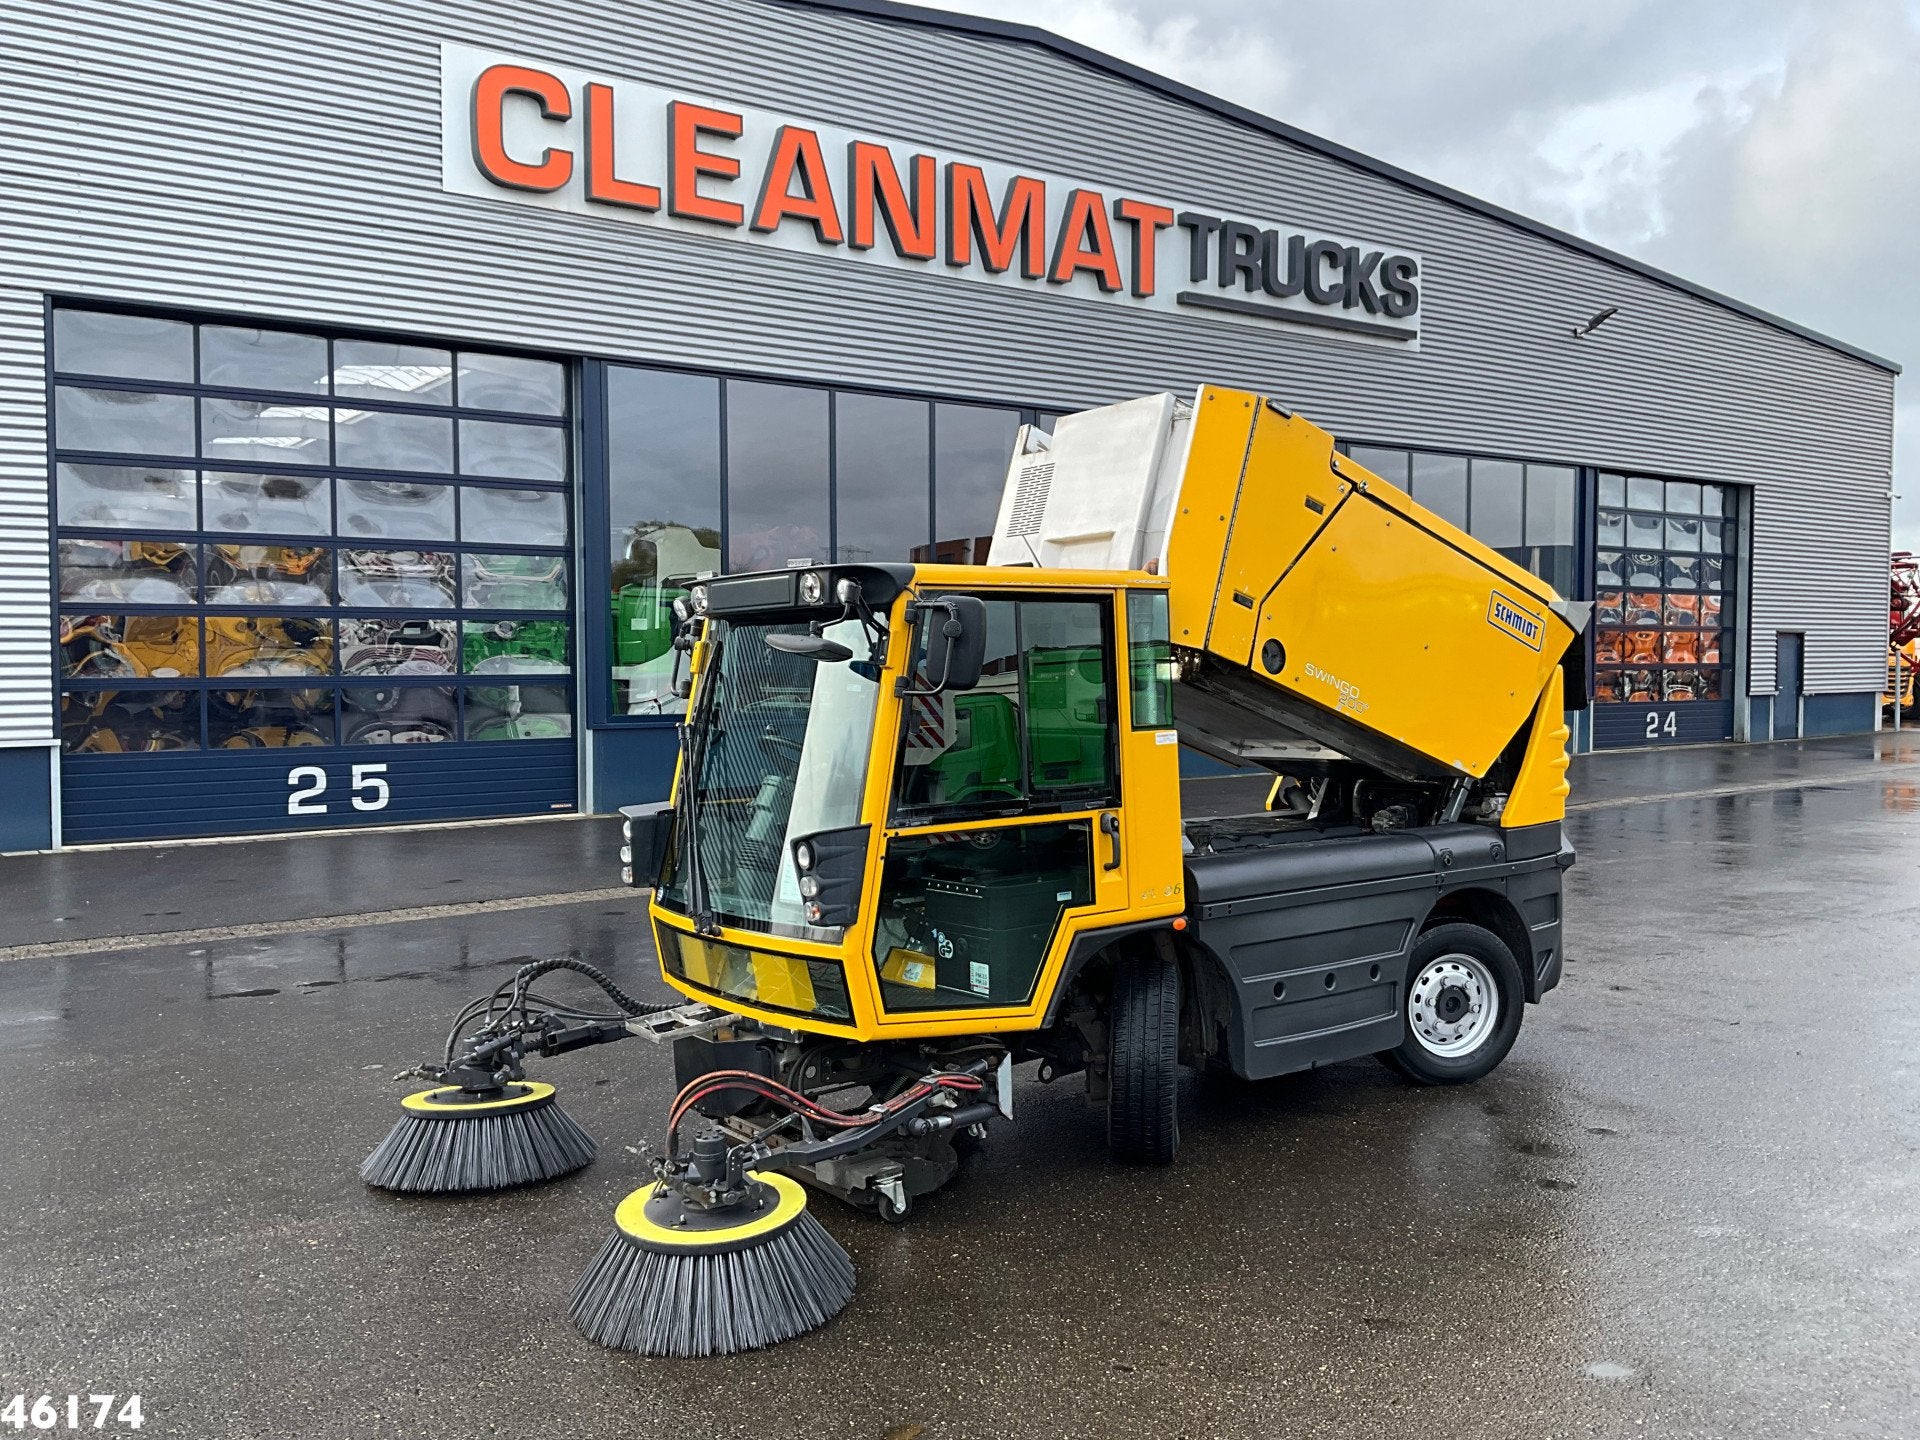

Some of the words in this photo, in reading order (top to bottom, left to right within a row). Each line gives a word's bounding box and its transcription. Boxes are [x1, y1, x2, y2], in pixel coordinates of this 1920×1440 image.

[470, 63, 1174, 298] CLEANMAT
[1177, 211, 1419, 319] TRUCKS
[1494, 602, 1539, 640] SCHMIDT
[1304, 662, 1360, 699] SWINGO
[1646, 711, 1677, 738] 24
[287, 763, 390, 815] 25
